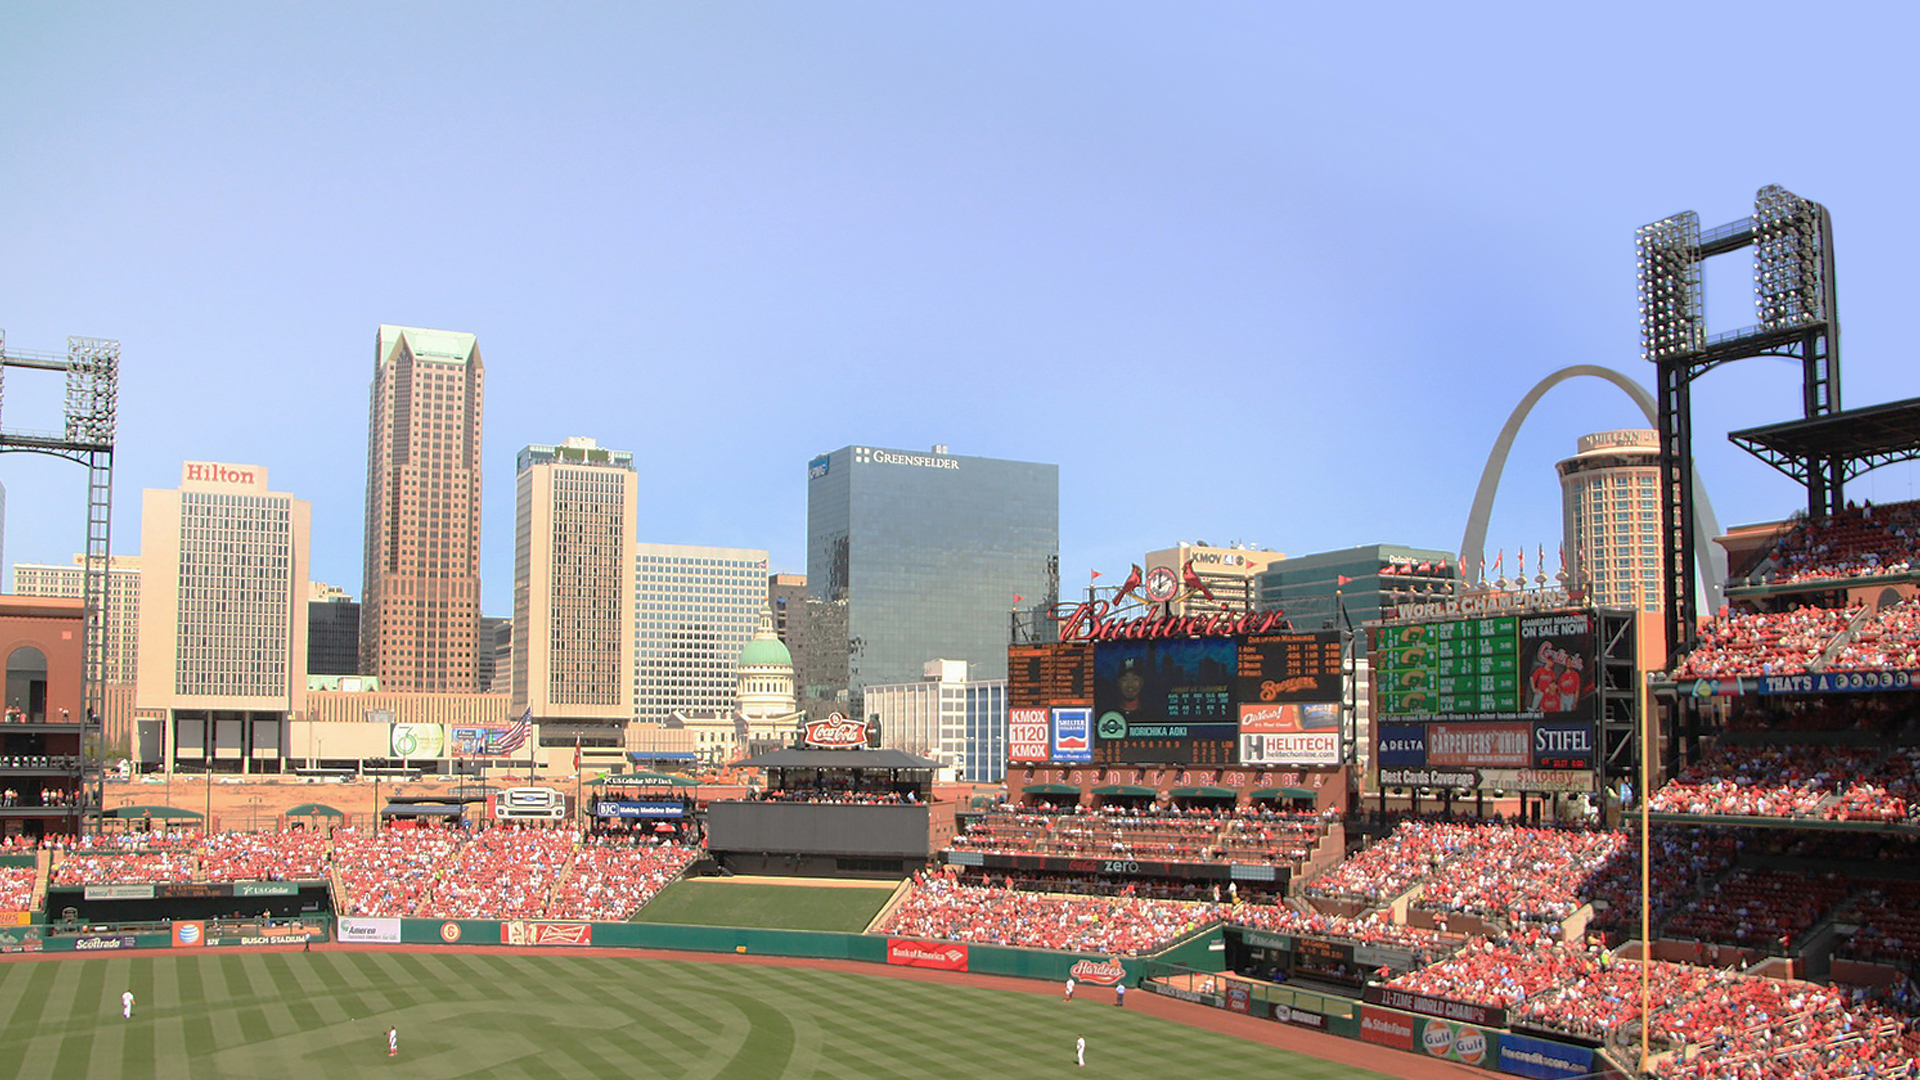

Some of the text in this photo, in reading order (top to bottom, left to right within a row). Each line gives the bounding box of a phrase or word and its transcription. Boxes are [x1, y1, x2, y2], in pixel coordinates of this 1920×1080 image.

[873, 450, 959, 469] GREENSFELDER
[187, 463, 255, 484] Hilton
[1192, 552, 1221, 564] KMOV
[1398, 590, 1570, 618] WORLD CHAMPIONS
[1047, 599, 1286, 641] Budweiser
[1521, 615, 1588, 627] GAMEDAY MAGAZINE
[1521, 622, 1588, 638] ON SALE NOW!
[1766, 672, 1909, 692] THAT'S A POWER
[1012, 710, 1046, 723] KMOX
[813, 723, 859, 742] Coca-Cola
[1012, 726, 1046, 741] 1120
[1536, 727, 1591, 751] STIFEL
[1012, 744, 1046, 757] KMOX
[1266, 738, 1334, 750] HELITECH
[1389, 740, 1424, 750] DELTA
[1498, 733, 1528, 753] UNION
[1108, 770, 1120, 786] 10
[1226, 772, 1245, 787] 42
[1381, 769, 1475, 787] Best Cards Coverage
[601, 804, 617, 814] BJC
[348, 926, 376, 935] Ameren
[76, 937, 121, 949] Scottrade
[241, 936, 269, 945] BUSCH
[270, 935, 306, 944] STADIUM
[893, 946, 945, 961] Bank of America
[1381, 990, 1486, 1022] 11-TIME WORLD CHAMPS
[1425, 1031, 1450, 1044] Gulf
[1456, 1038, 1483, 1052] Gulf
